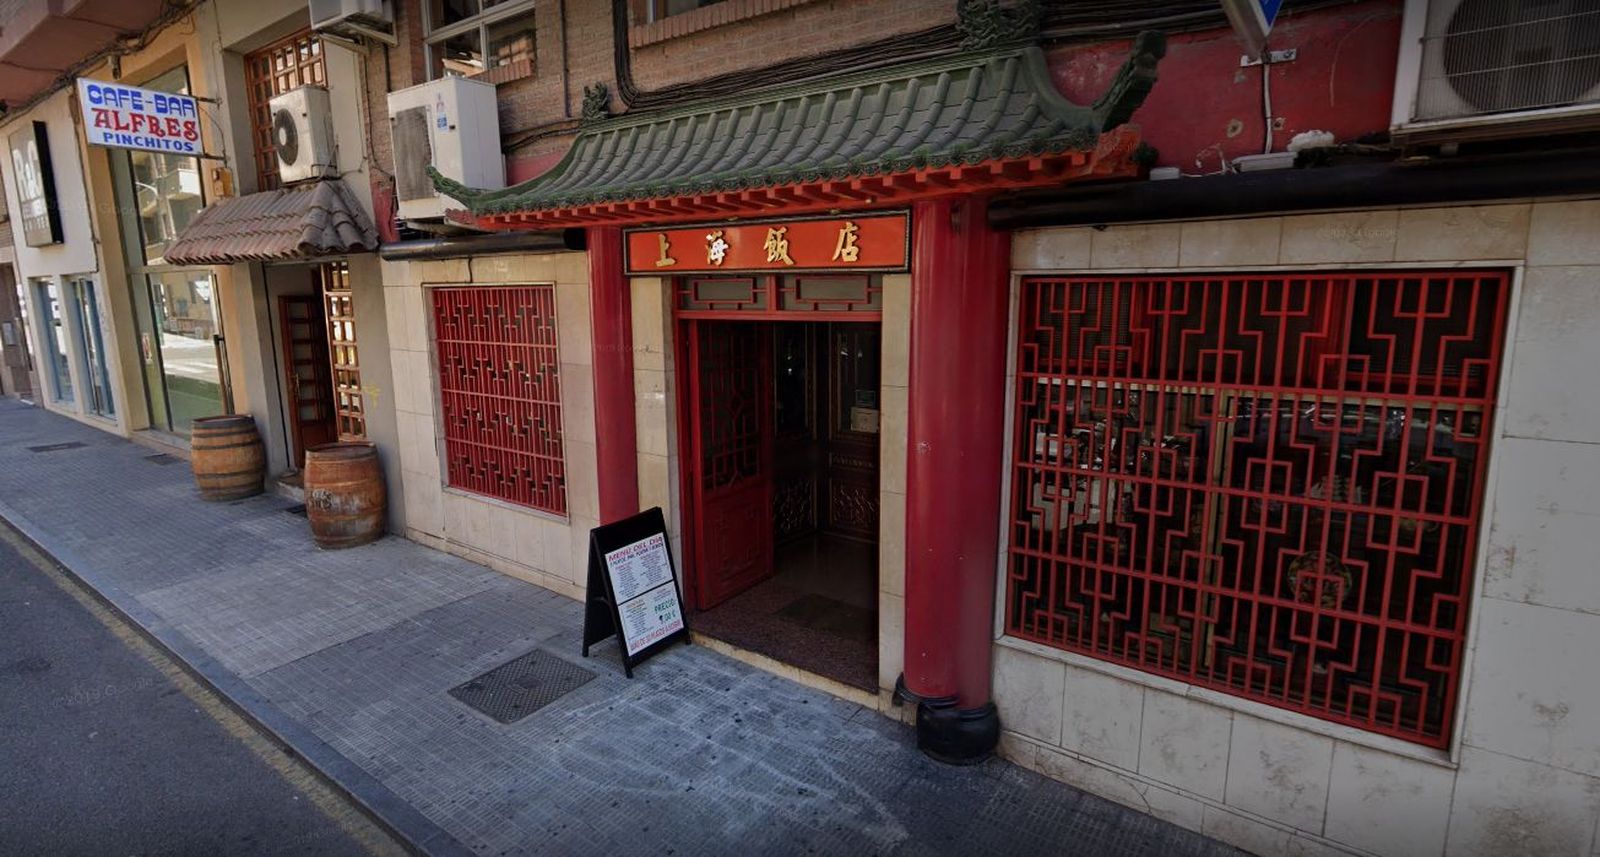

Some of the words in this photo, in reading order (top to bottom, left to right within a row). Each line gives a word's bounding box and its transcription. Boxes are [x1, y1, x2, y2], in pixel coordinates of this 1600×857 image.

[87, 84, 196, 117] CAFE-BAR
[91, 107, 199, 142] ALFRES
[103, 132, 194, 152] PINCHITOS
[655, 221, 860, 267] 上海飯店
